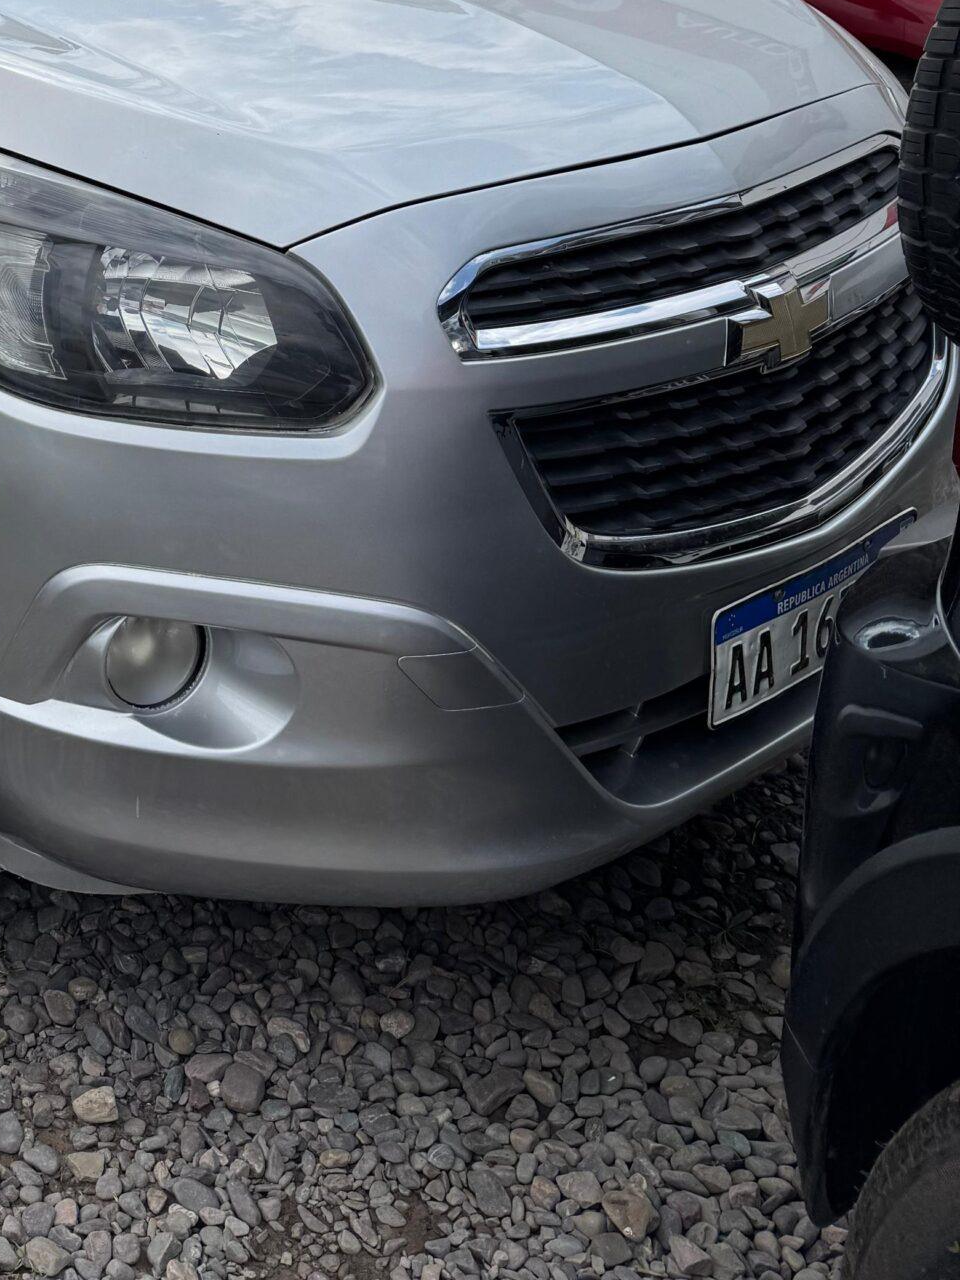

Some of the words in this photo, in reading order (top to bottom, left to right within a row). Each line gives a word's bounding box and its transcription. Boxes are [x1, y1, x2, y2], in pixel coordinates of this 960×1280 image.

[777, 581, 826, 616] REPUBLICA
[828, 554, 869, 588] ARGENTINA
[726, 630, 774, 709] AA
